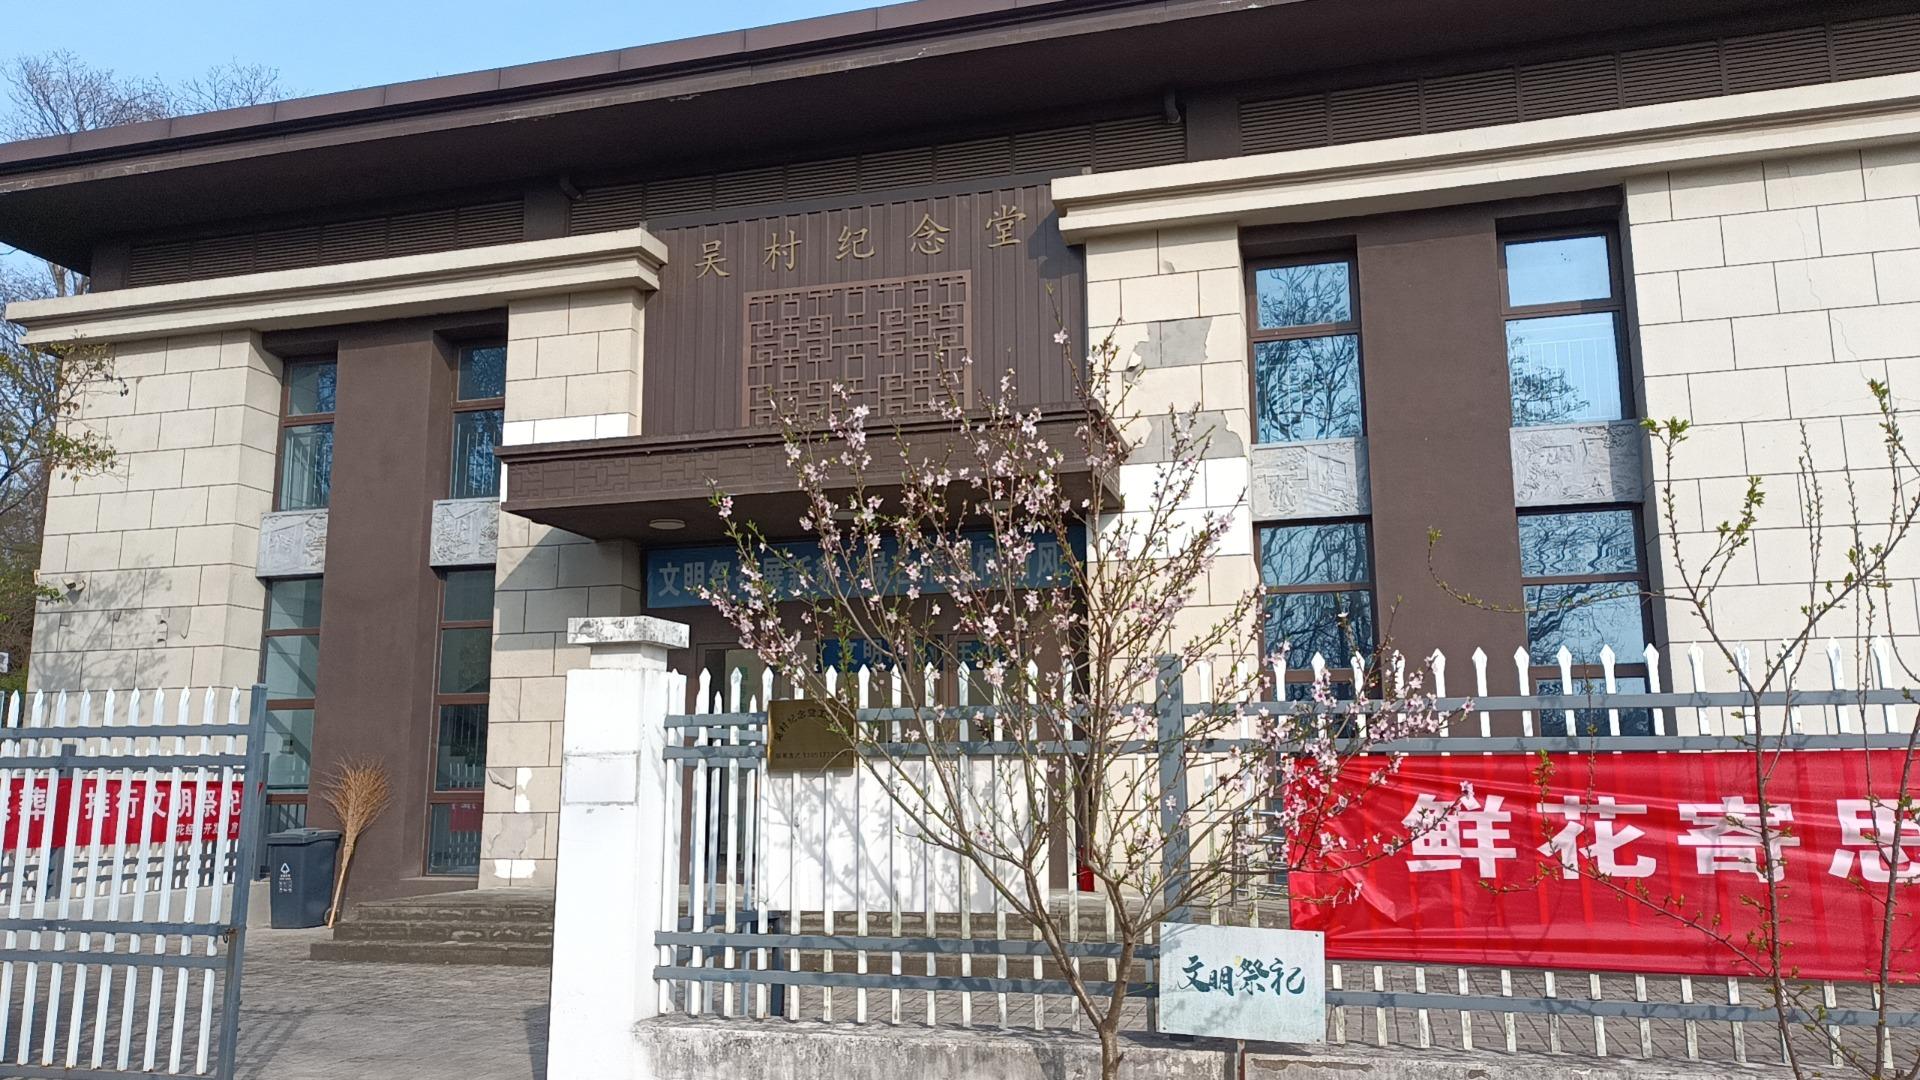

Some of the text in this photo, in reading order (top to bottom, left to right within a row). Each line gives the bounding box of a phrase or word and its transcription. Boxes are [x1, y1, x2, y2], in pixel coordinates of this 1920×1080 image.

[695, 205, 1026, 279] 吴村纪念堂
[1177, 955, 1305, 996] 文明祭祀
